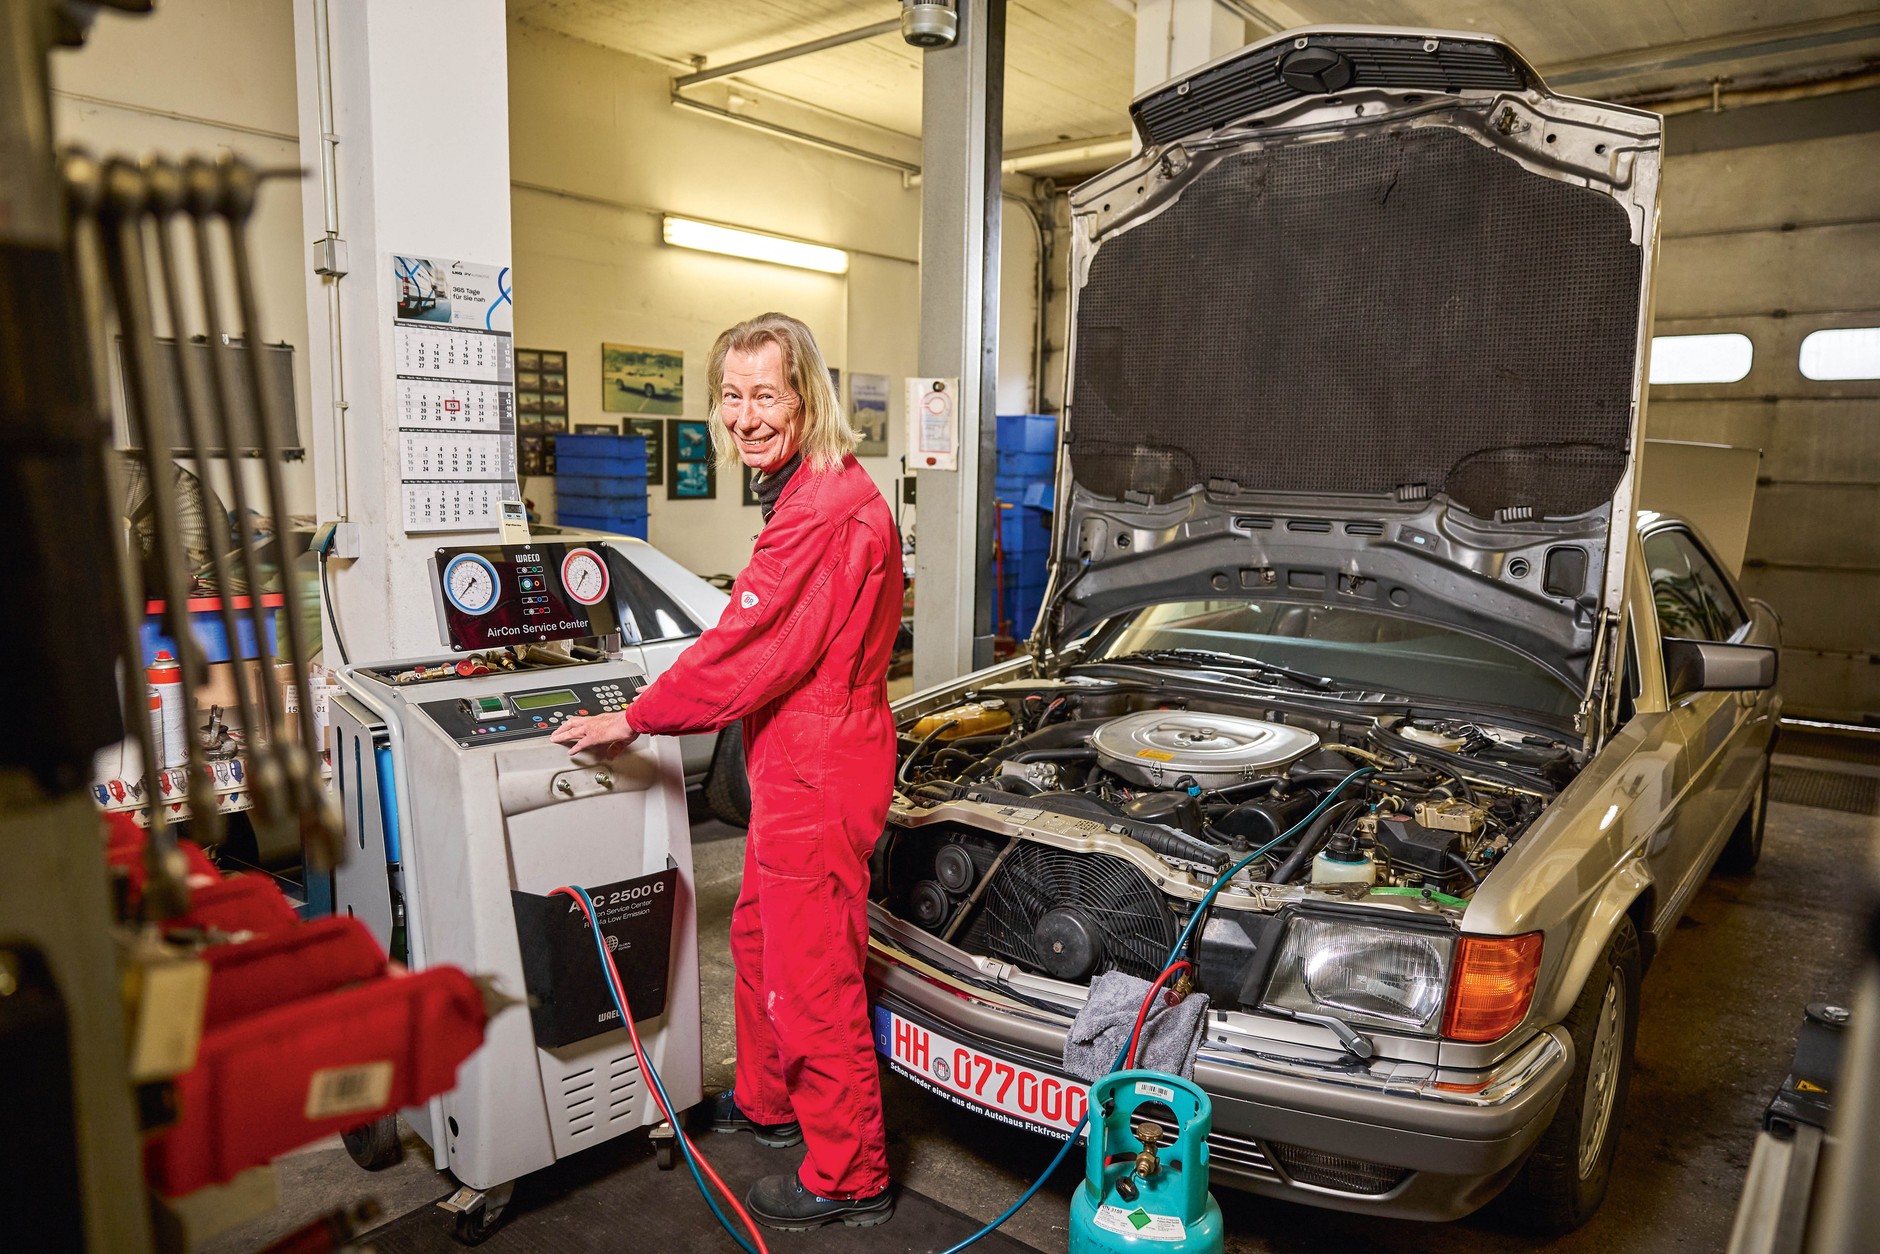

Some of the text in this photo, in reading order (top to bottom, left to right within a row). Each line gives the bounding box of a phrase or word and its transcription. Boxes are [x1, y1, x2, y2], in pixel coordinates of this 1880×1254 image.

[466, 288, 480, 296] Tage
[516, 554, 540, 563] WAECO
[487, 619, 589, 638] AirCon Service Center
[568, 882, 664, 913] AC 2500 G
[607, 906, 630, 915] Service
[631, 900, 652, 910] Center
[623, 908, 650, 919] Emission
[881, 1034, 886, 1045] D
[895, 1018, 1087, 1127] HH 077000
[890, 1062, 908, 1078] Schon
[909, 1074, 931, 1090] wieder
[932, 1086, 950, 1100] einer
[952, 1097, 965, 1106] aus
[966, 1102, 983, 1115] dem
[984, 1109, 1023, 1128] Autohaus
